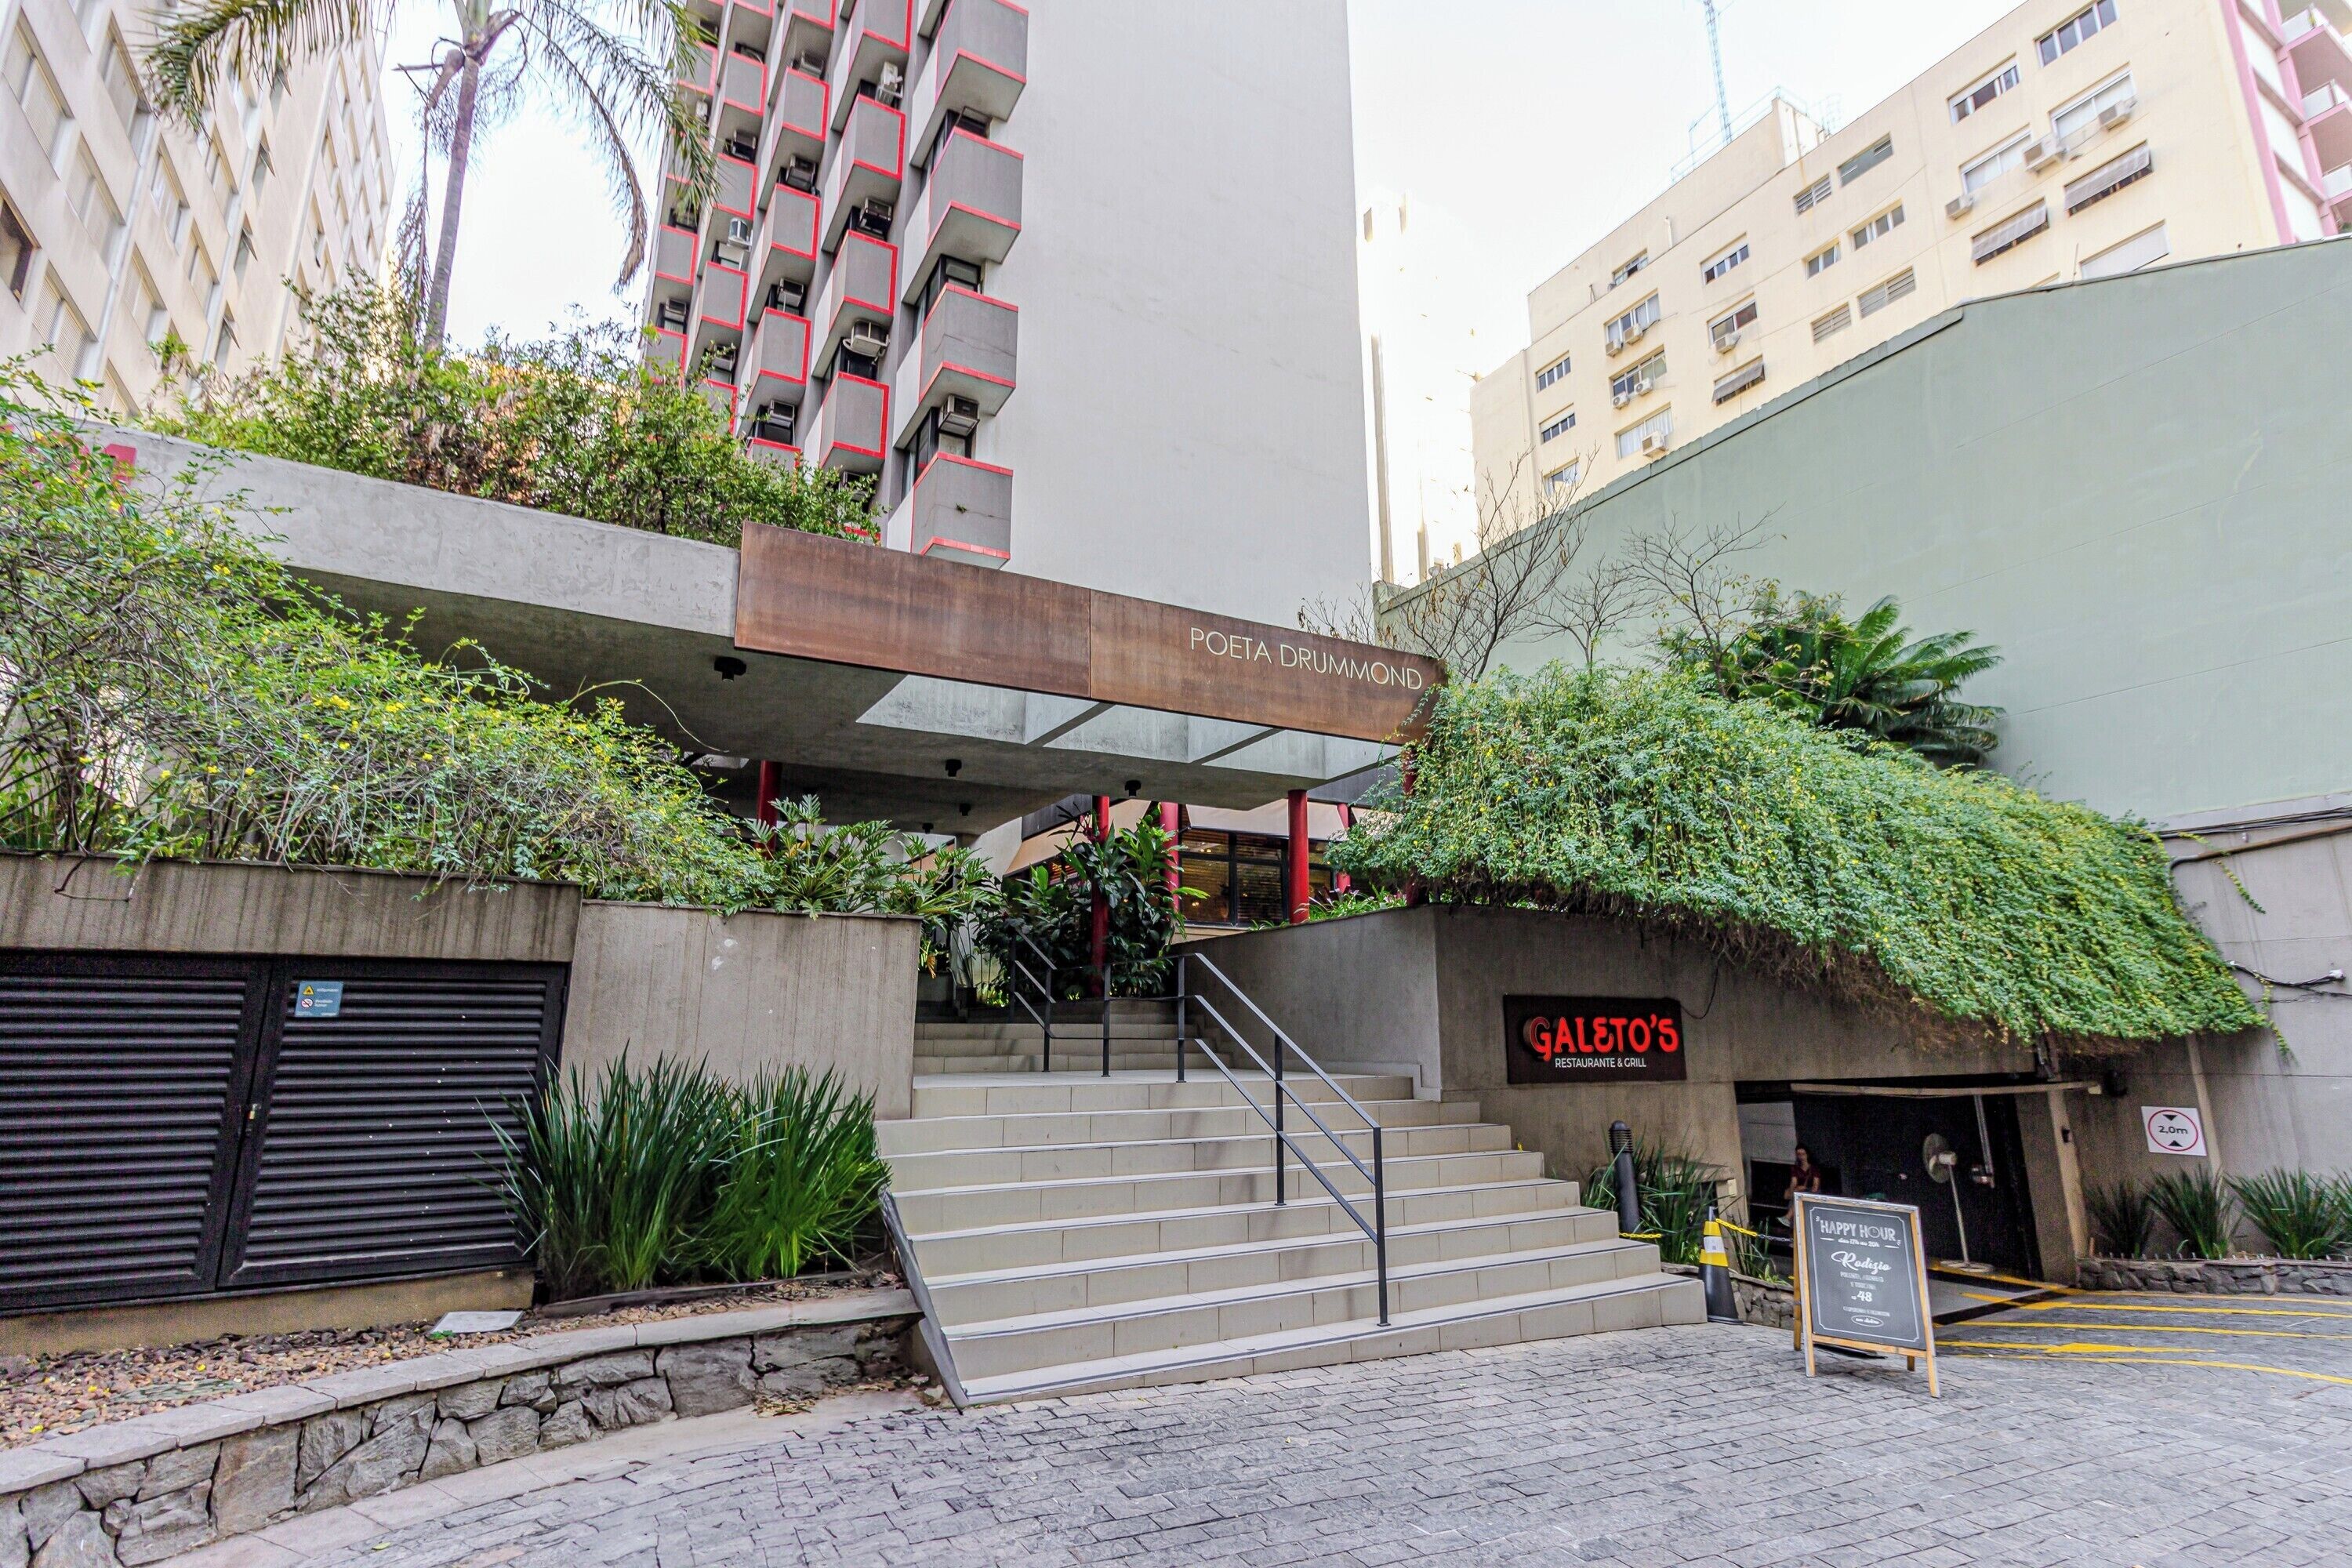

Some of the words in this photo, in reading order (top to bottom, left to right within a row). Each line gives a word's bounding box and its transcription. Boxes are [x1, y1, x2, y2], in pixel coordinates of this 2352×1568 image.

[1190, 626, 1272, 664] POETA
[1279, 644, 1423, 691] DRUMMOND
[1528, 1013, 1679, 1062] GALETO'S
[1555, 1058, 1616, 1068] RESTAURANTE
[1617, 1058, 1623, 1067] &
[1624, 1058, 1646, 1068] GRILL
[2157, 1125, 2188, 1135] 2,0m
[1820, 1220, 1856, 1237] HAPPY
[1859, 1224, 1896, 1241] HOUR
[1857, 1290, 1873, 1302] 48
